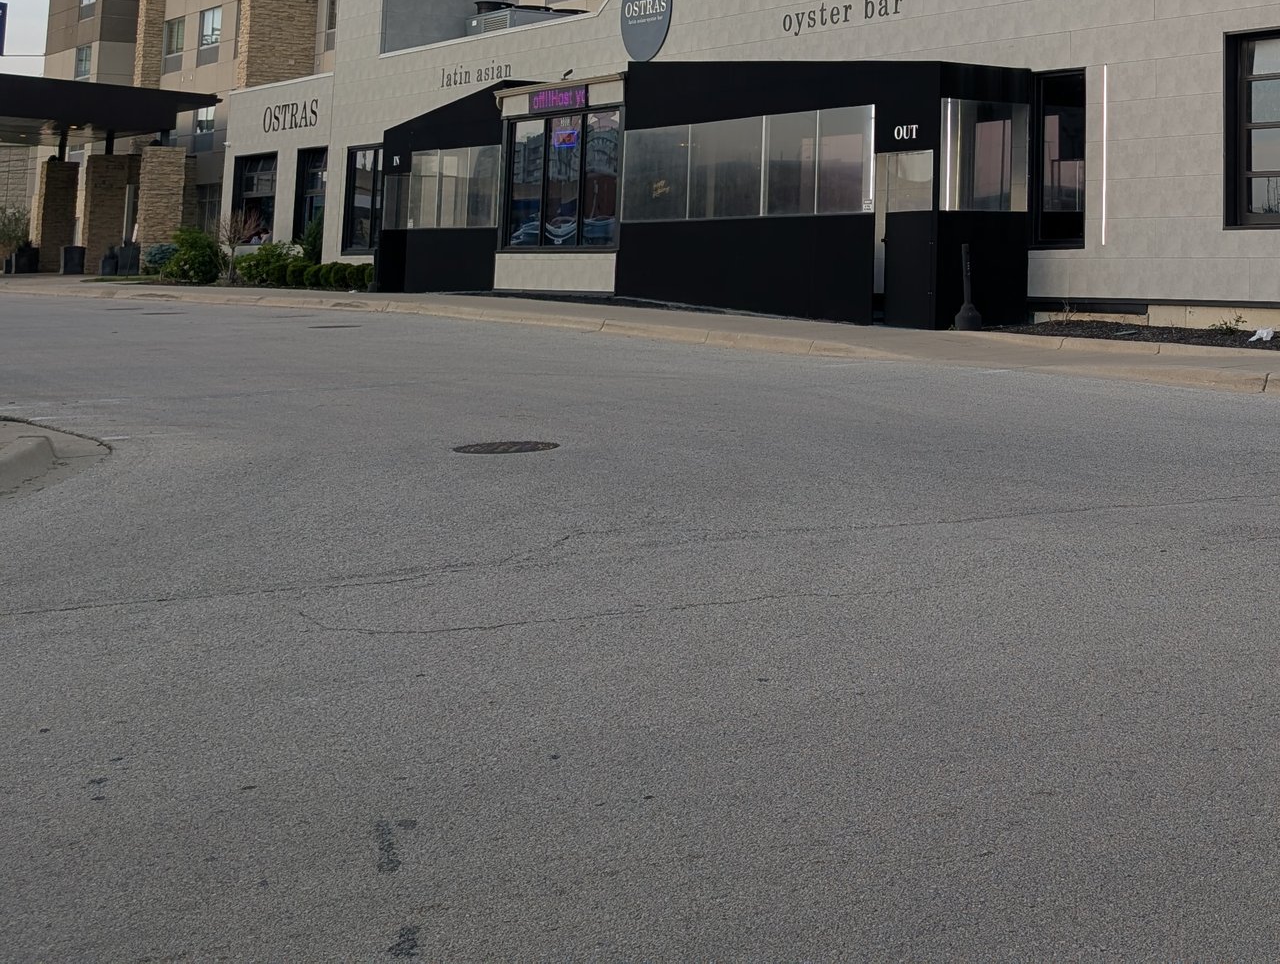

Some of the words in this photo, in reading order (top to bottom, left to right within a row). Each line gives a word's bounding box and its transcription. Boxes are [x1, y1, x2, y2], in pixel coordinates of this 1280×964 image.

[782, 2, 852, 36] oyster
[440, 65, 471, 88] latin
[476, 59, 512, 83] asian
[263, 98, 319, 133] OSTRAS
[894, 124, 919, 140] OUT
